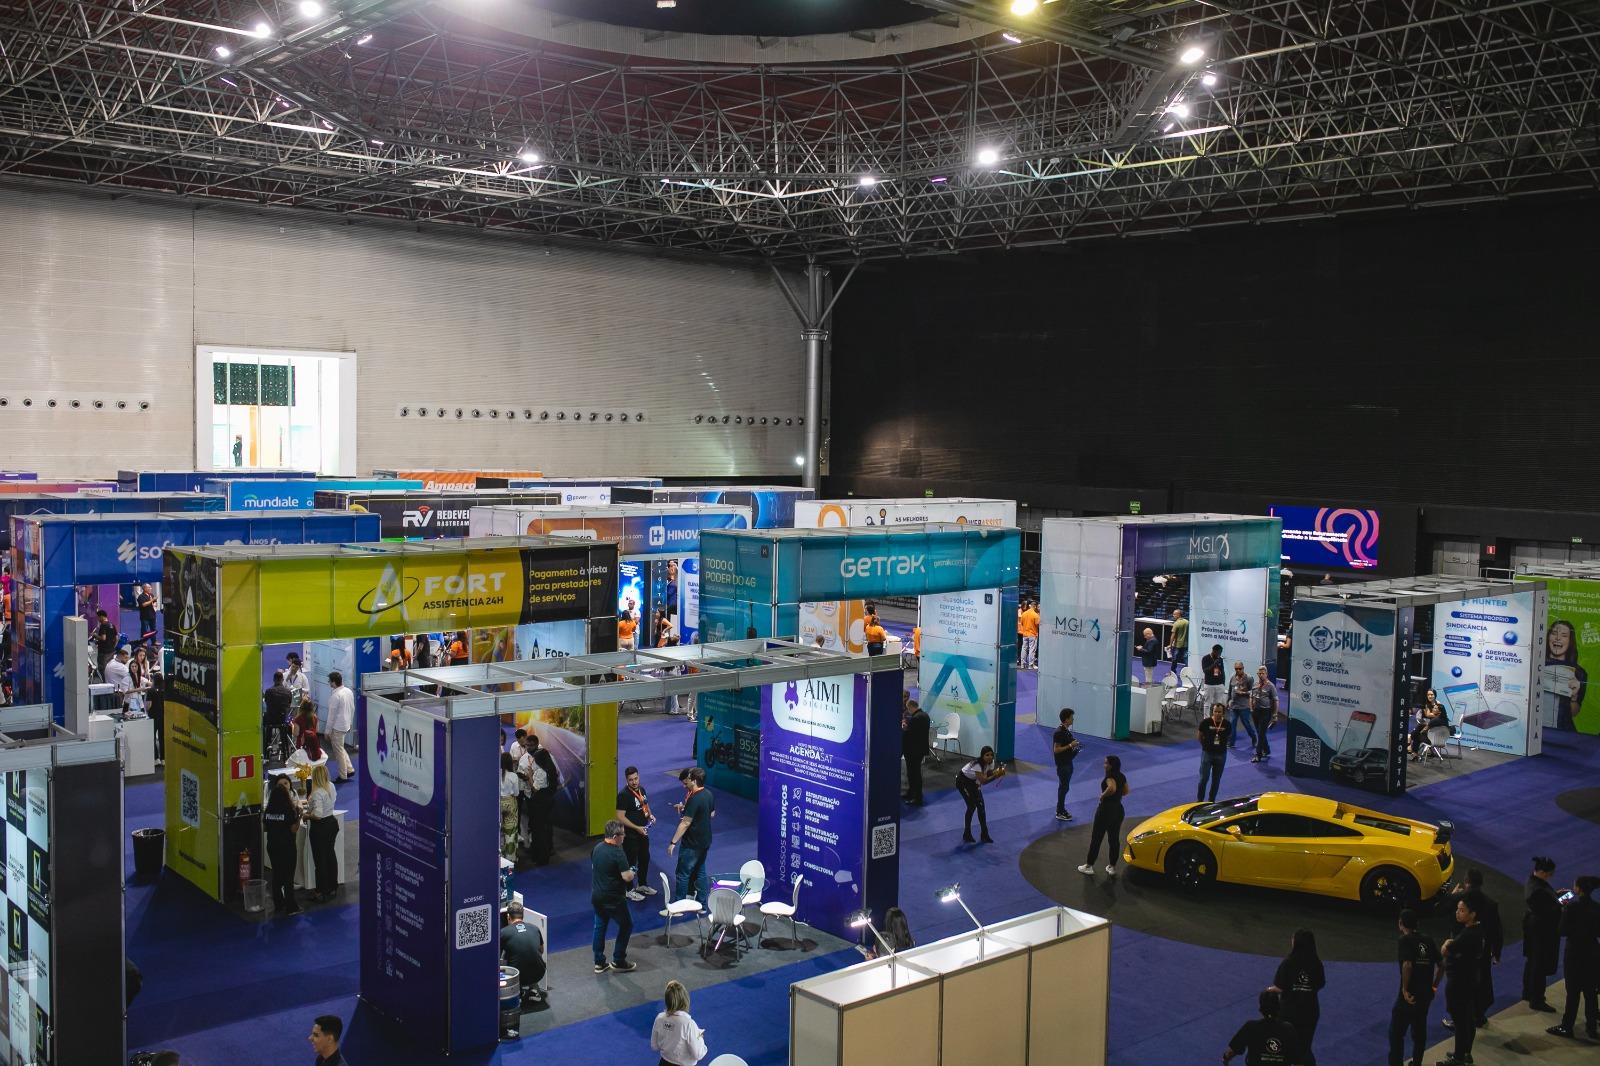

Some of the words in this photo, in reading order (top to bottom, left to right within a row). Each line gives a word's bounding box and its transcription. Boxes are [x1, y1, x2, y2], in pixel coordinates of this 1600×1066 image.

[667, 529, 700, 540] HINOV
[1189, 536, 1215, 554] MGI
[706, 558, 727, 570] TODO
[728, 561, 734, 571] O
[529, 568, 578, 580] Pagamento
[579, 566, 586, 576] à
[586, 565, 608, 574] vista
[706, 572, 731, 584] PODER
[732, 574, 744, 586] DO
[424, 572, 506, 596] FORT
[530, 582, 550, 592] para
[551, 578, 602, 590] prestadores
[529, 594, 541, 603] de
[542, 593, 576, 604] serviços
[1558, 591, 1600, 599] CERTIFICAÇÃ
[423, 597, 484, 610] ASSISTÊNCIA
[486, 596, 504, 606] 24H
[1472, 598, 1508, 607] HUNTER
[1055, 616, 1083, 632] MGI
[1201, 626, 1223, 636] Próximo
[1446, 622, 1488, 631] SINDICÂNCIA
[1229, 635, 1248, 643] Gestão
[1334, 630, 1372, 653] SKULL
[174, 656, 207, 686] FORT
[1317, 666, 1349, 675] RESPOSTA
[1534, 596, 1545, 740] SINDICÂNCIA
[804, 678, 840, 705] AIMI
[1316, 680, 1361, 691] RASTREAMENTO
[803, 700, 839, 714] DIGITAL
[392, 725, 422, 759] AIMI
[739, 738, 758, 754] 95%
[1396, 698, 1405, 788] RESPOSTA
[391, 750, 422, 770] DIGITAL
[803, 861, 834, 876] CONSULTORIA
[463, 894, 484, 904] acesse:
